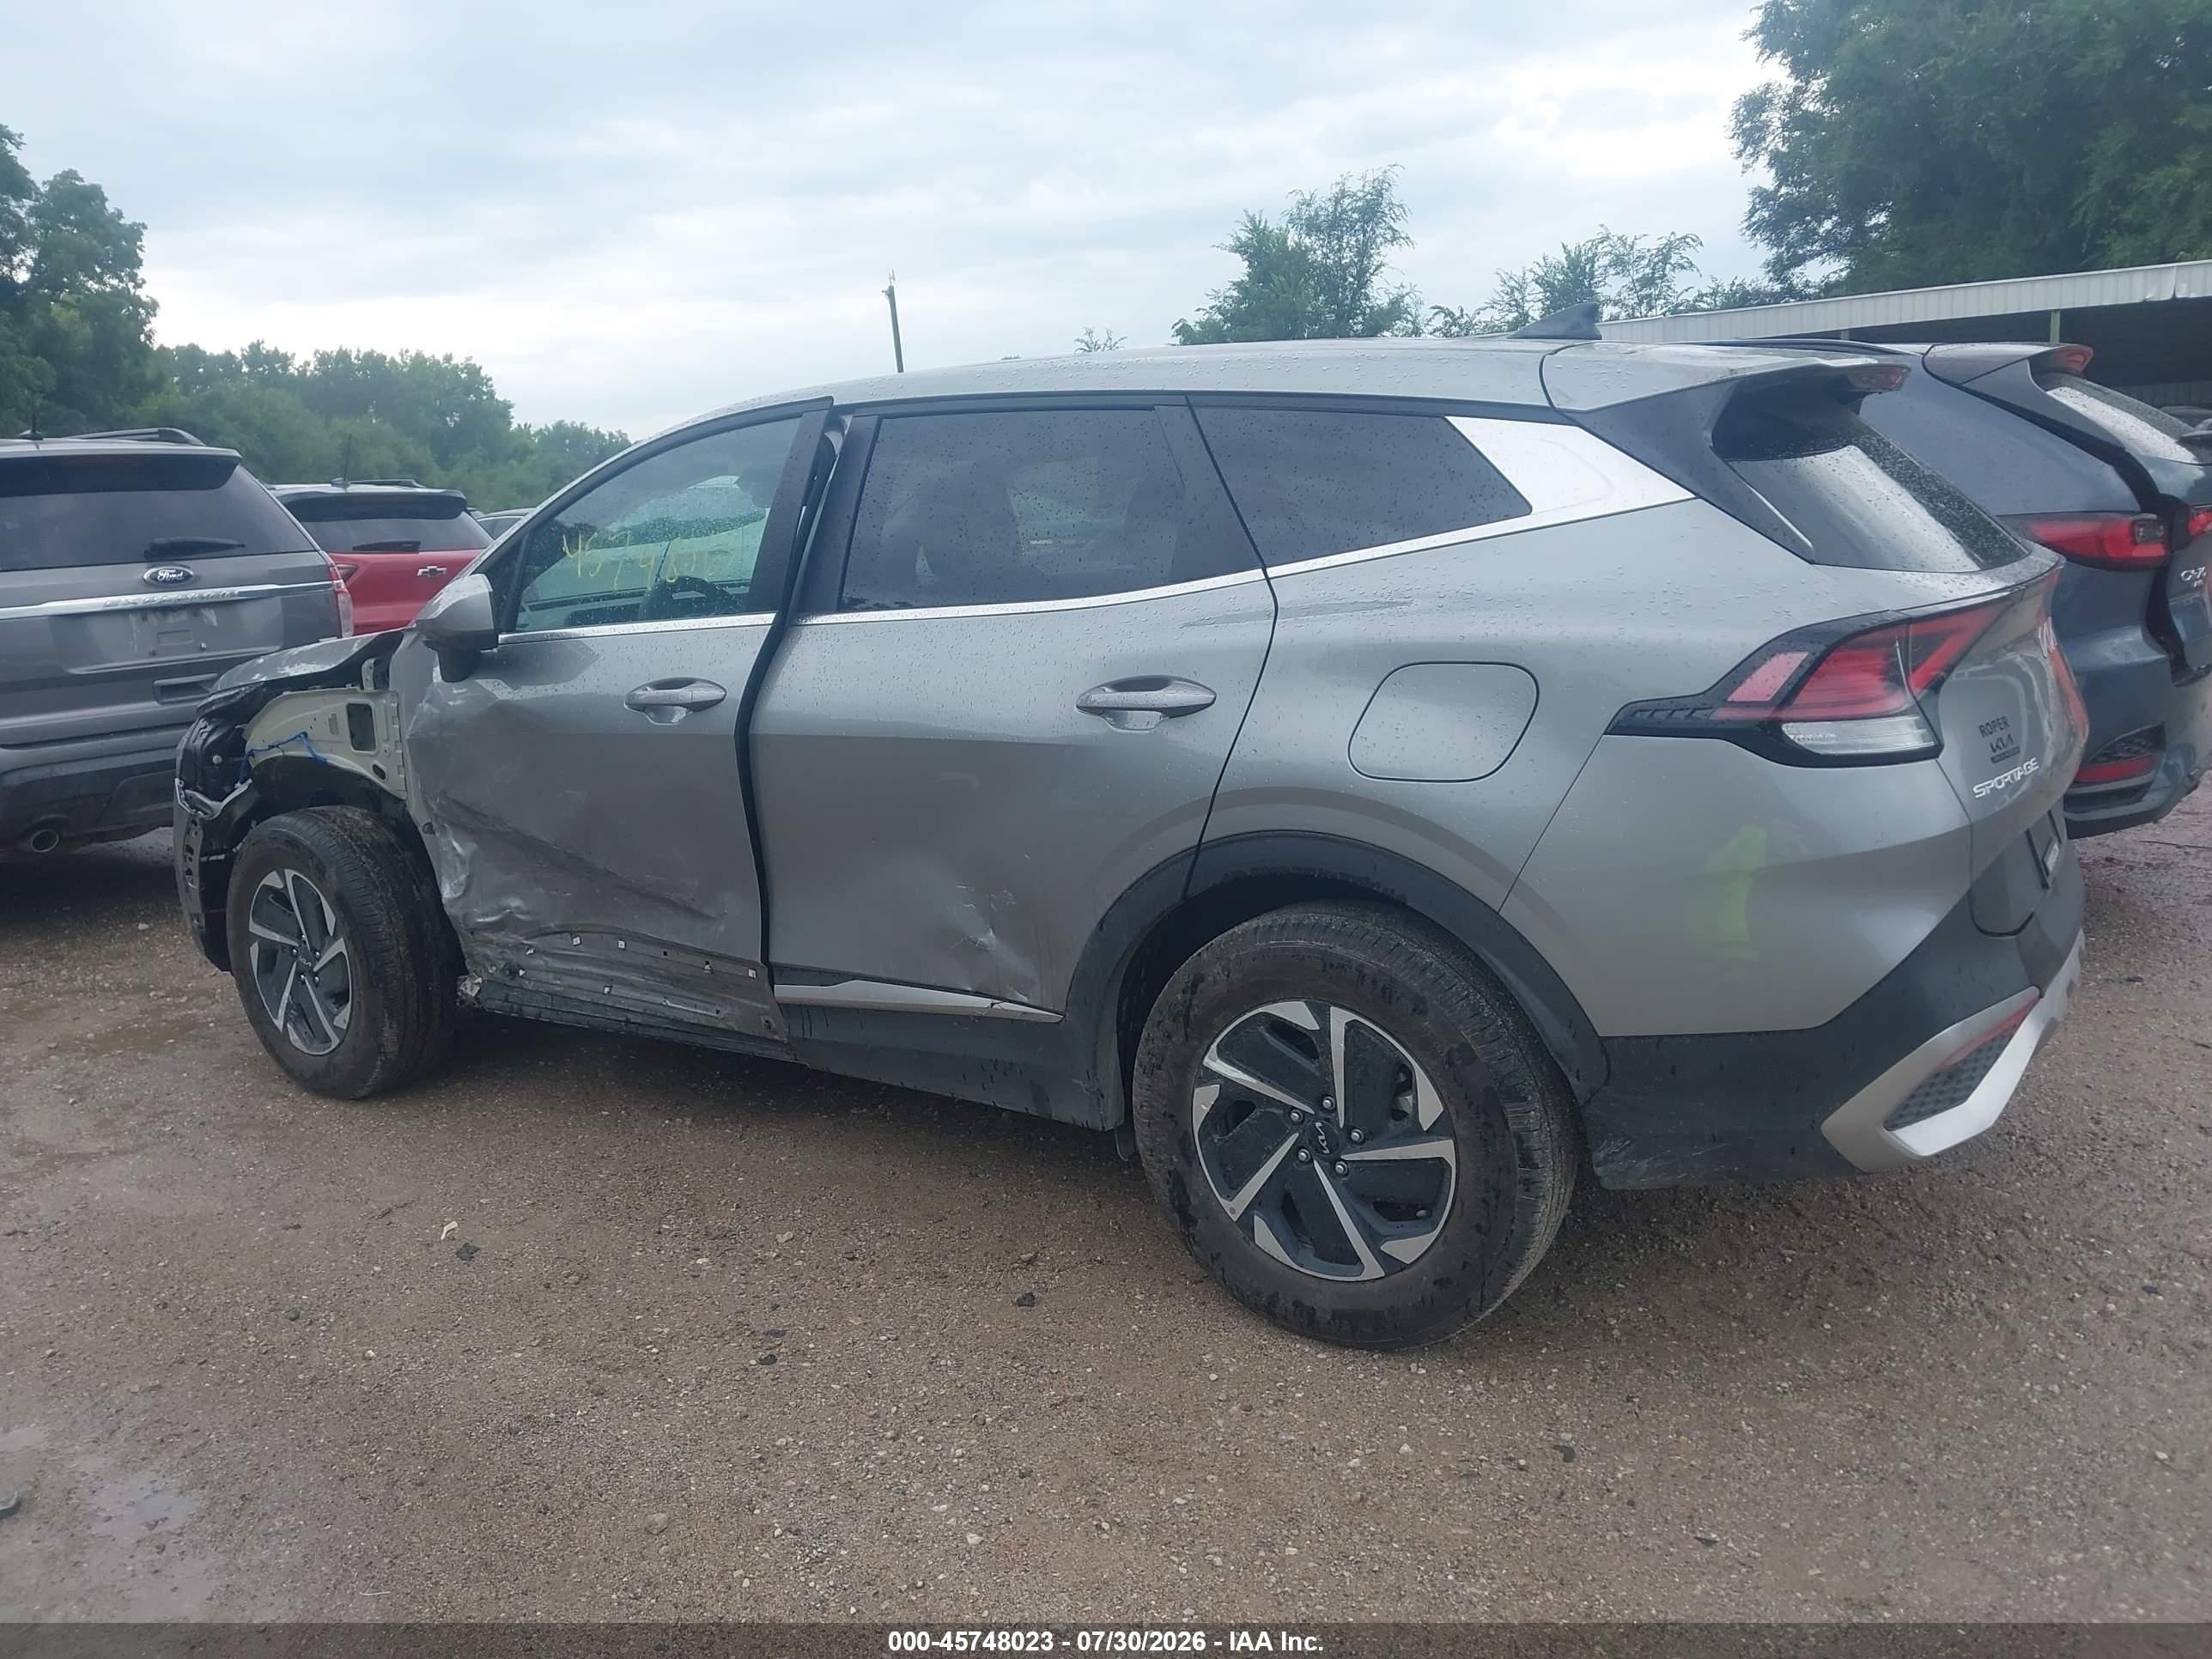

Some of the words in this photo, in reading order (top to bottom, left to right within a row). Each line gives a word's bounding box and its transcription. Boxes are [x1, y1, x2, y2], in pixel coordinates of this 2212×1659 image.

[157, 568, 185, 582] Ford
[1978, 715, 2010, 738] ROPER
[1972, 757, 2040, 799] SPORTAGE
